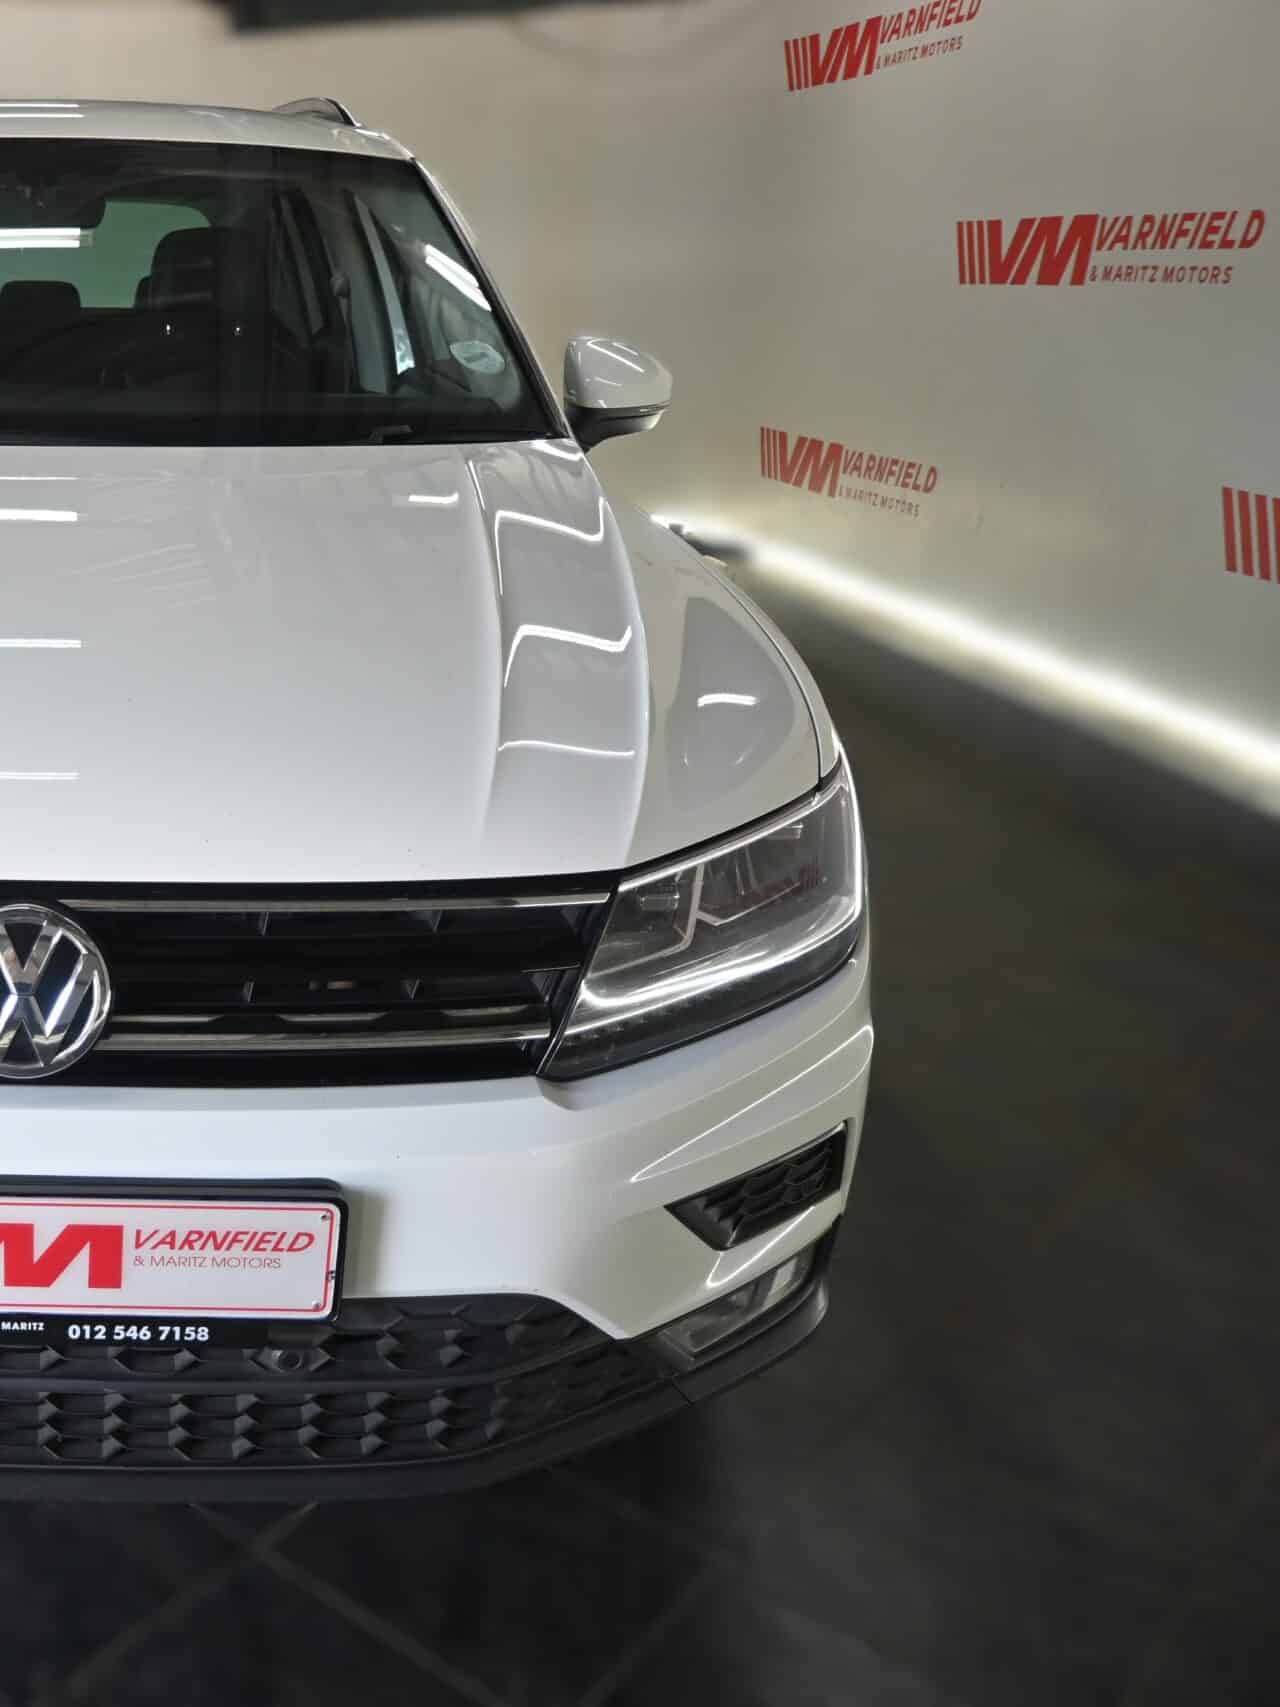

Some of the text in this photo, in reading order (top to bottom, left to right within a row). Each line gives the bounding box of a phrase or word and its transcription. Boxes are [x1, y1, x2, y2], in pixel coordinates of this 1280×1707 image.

[880, 0, 983, 44] VARNFIELD
[919, 35, 963, 58] MOTORS
[1096, 209, 1265, 251] VARNFIELD
[1089, 264, 1233, 285] & MARITZ MOTORS
[842, 448, 937, 493] VARNFIELD
[134, 1228, 315, 1254] VARNFIELD
[133, 1255, 282, 1270] & MARITZ MOTORS
[1, 1321, 45, 1332] MARITZ
[68, 1324, 209, 1342] 012 546 7158
